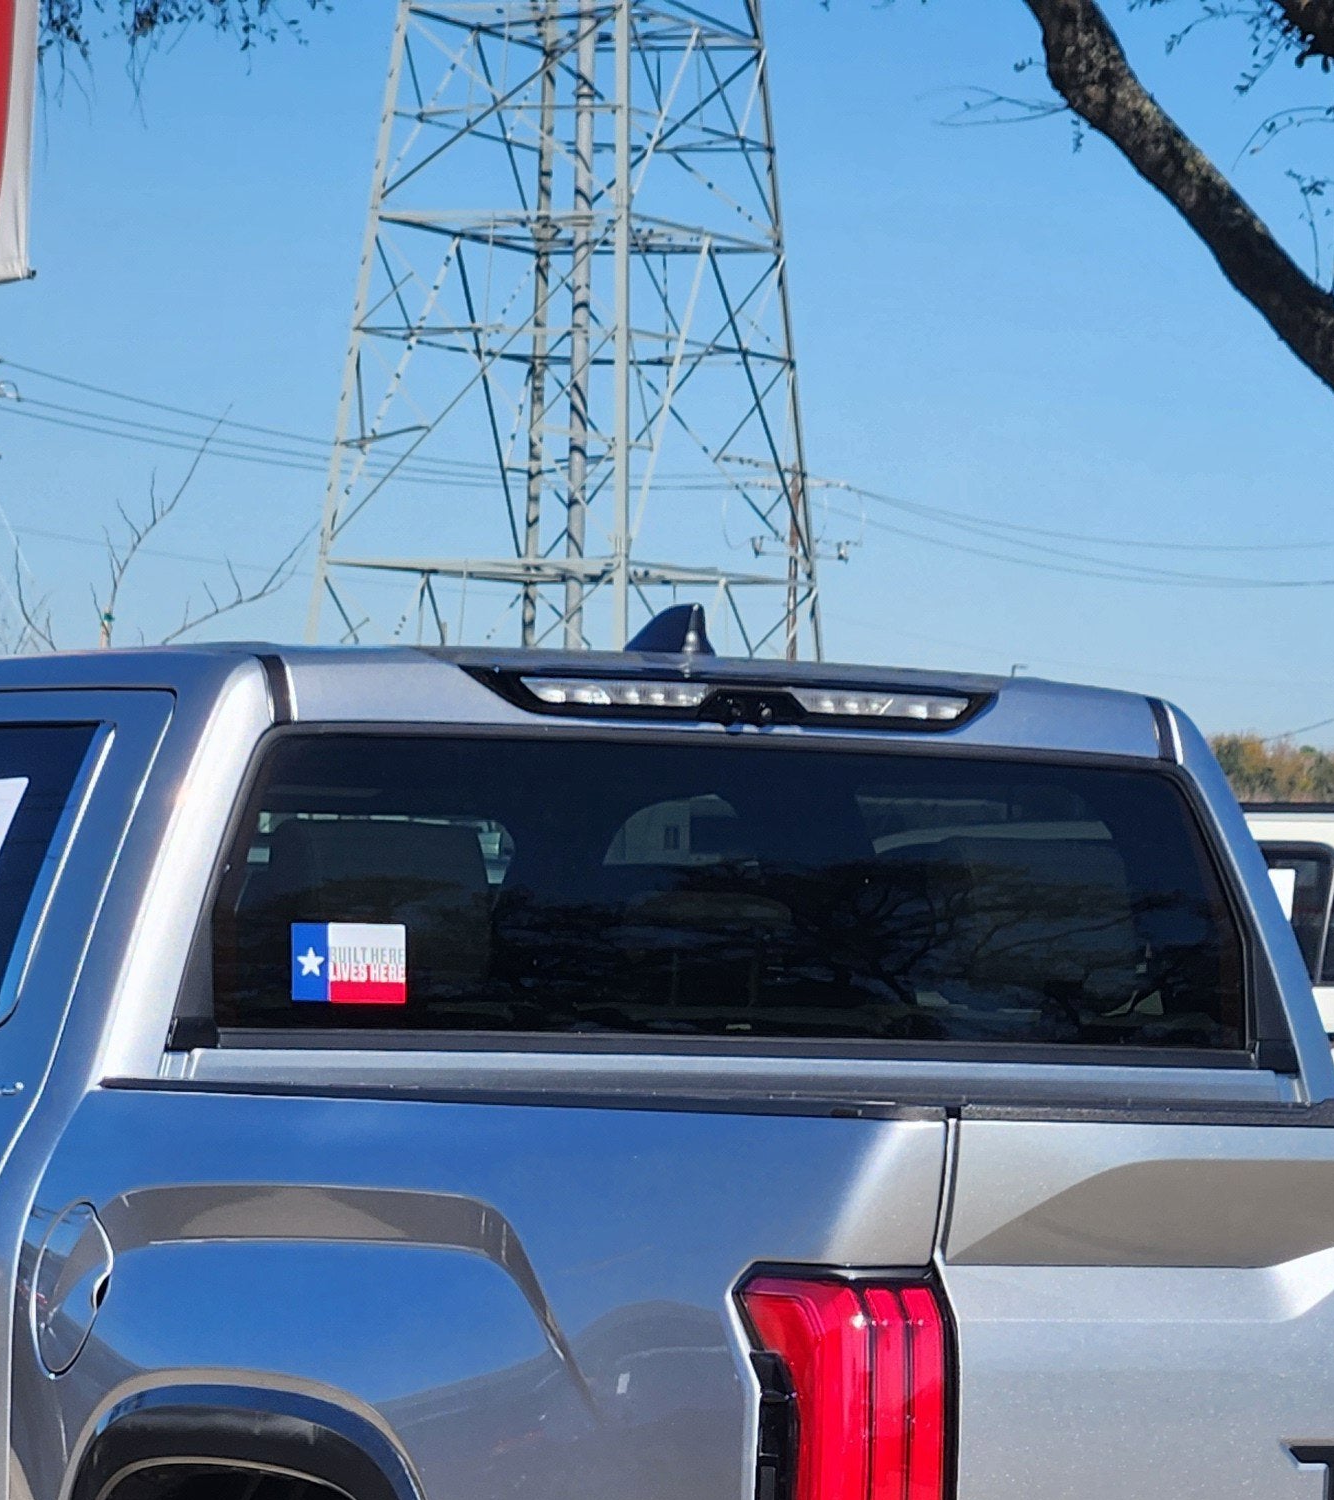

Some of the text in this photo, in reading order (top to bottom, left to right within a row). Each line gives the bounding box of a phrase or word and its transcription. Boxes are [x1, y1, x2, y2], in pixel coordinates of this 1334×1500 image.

[329, 946, 406, 965] BUILT HERE
[329, 962, 406, 983] LIVES HERE
